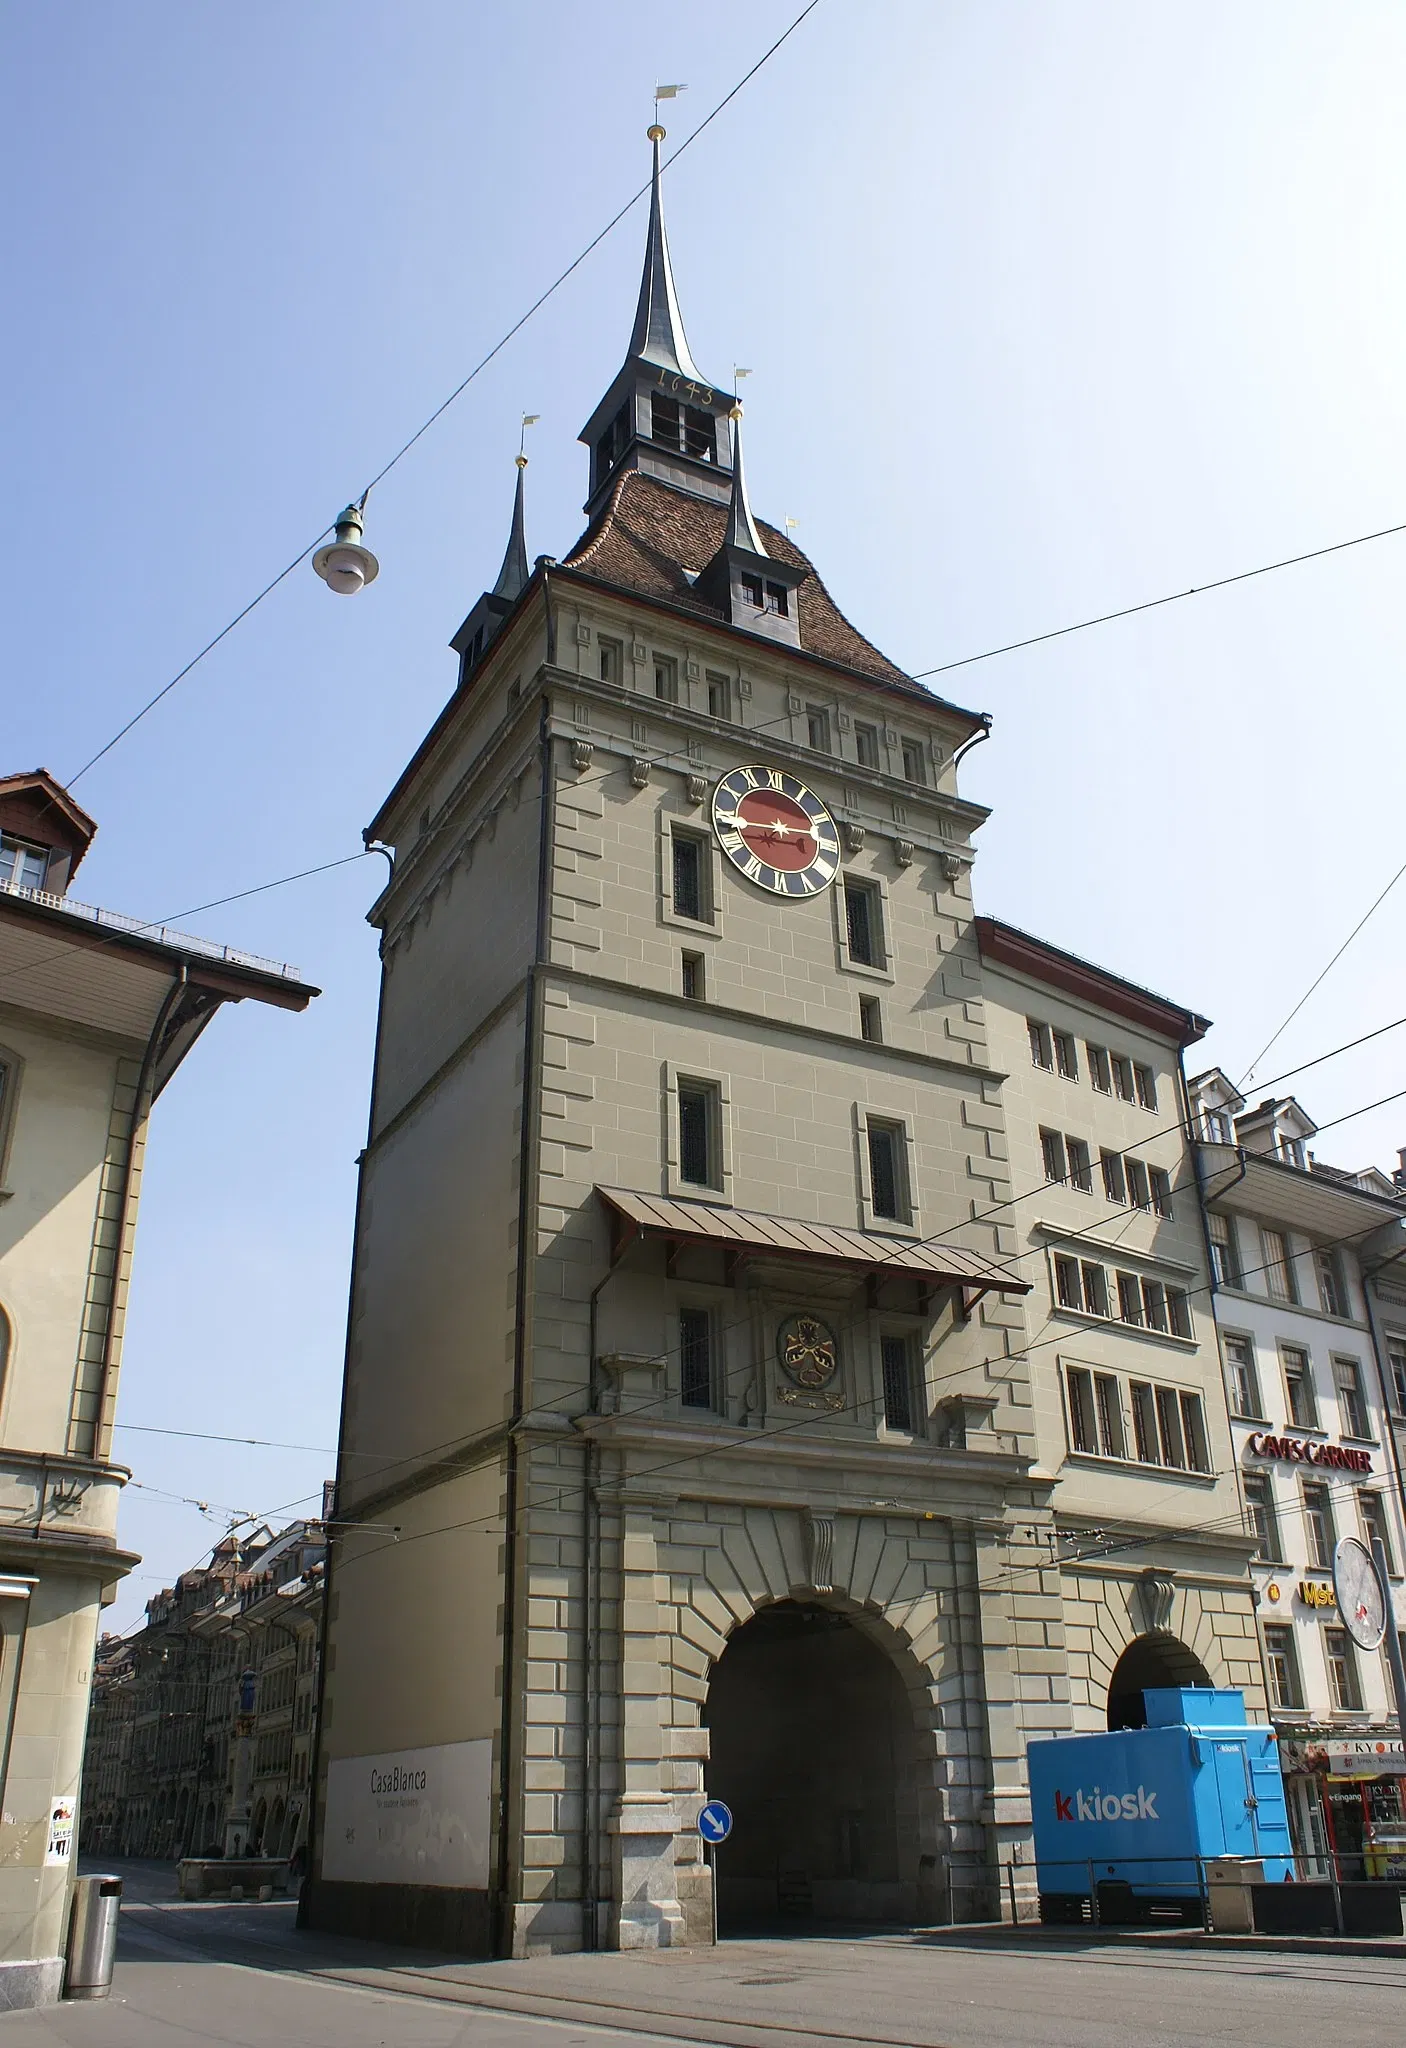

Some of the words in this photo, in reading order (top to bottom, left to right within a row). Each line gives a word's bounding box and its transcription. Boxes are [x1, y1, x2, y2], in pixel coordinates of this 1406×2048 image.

[657, 368, 713, 405] 1643
[740, 768, 759, 789] XI
[766, 769, 783, 791] XII
[720, 781, 742, 802] X
[795, 786, 807, 802] I
[773, 870, 789, 893] VI
[800, 872, 816, 893] V
[1249, 1431, 1304, 1461] CAVES
[1303, 1441, 1374, 1473] GARNIER
[1297, 1581, 1337, 1609] Mist
[1221, 1743, 1240, 1753] kiosk
[371, 1766, 427, 1794] CasaBlanca
[1372, 1784, 1401, 1796] KYOTO
[1055, 1788, 1075, 1821] k
[1076, 1784, 1160, 1821] kiosk
[1334, 1793, 1362, 1803] Eingang
